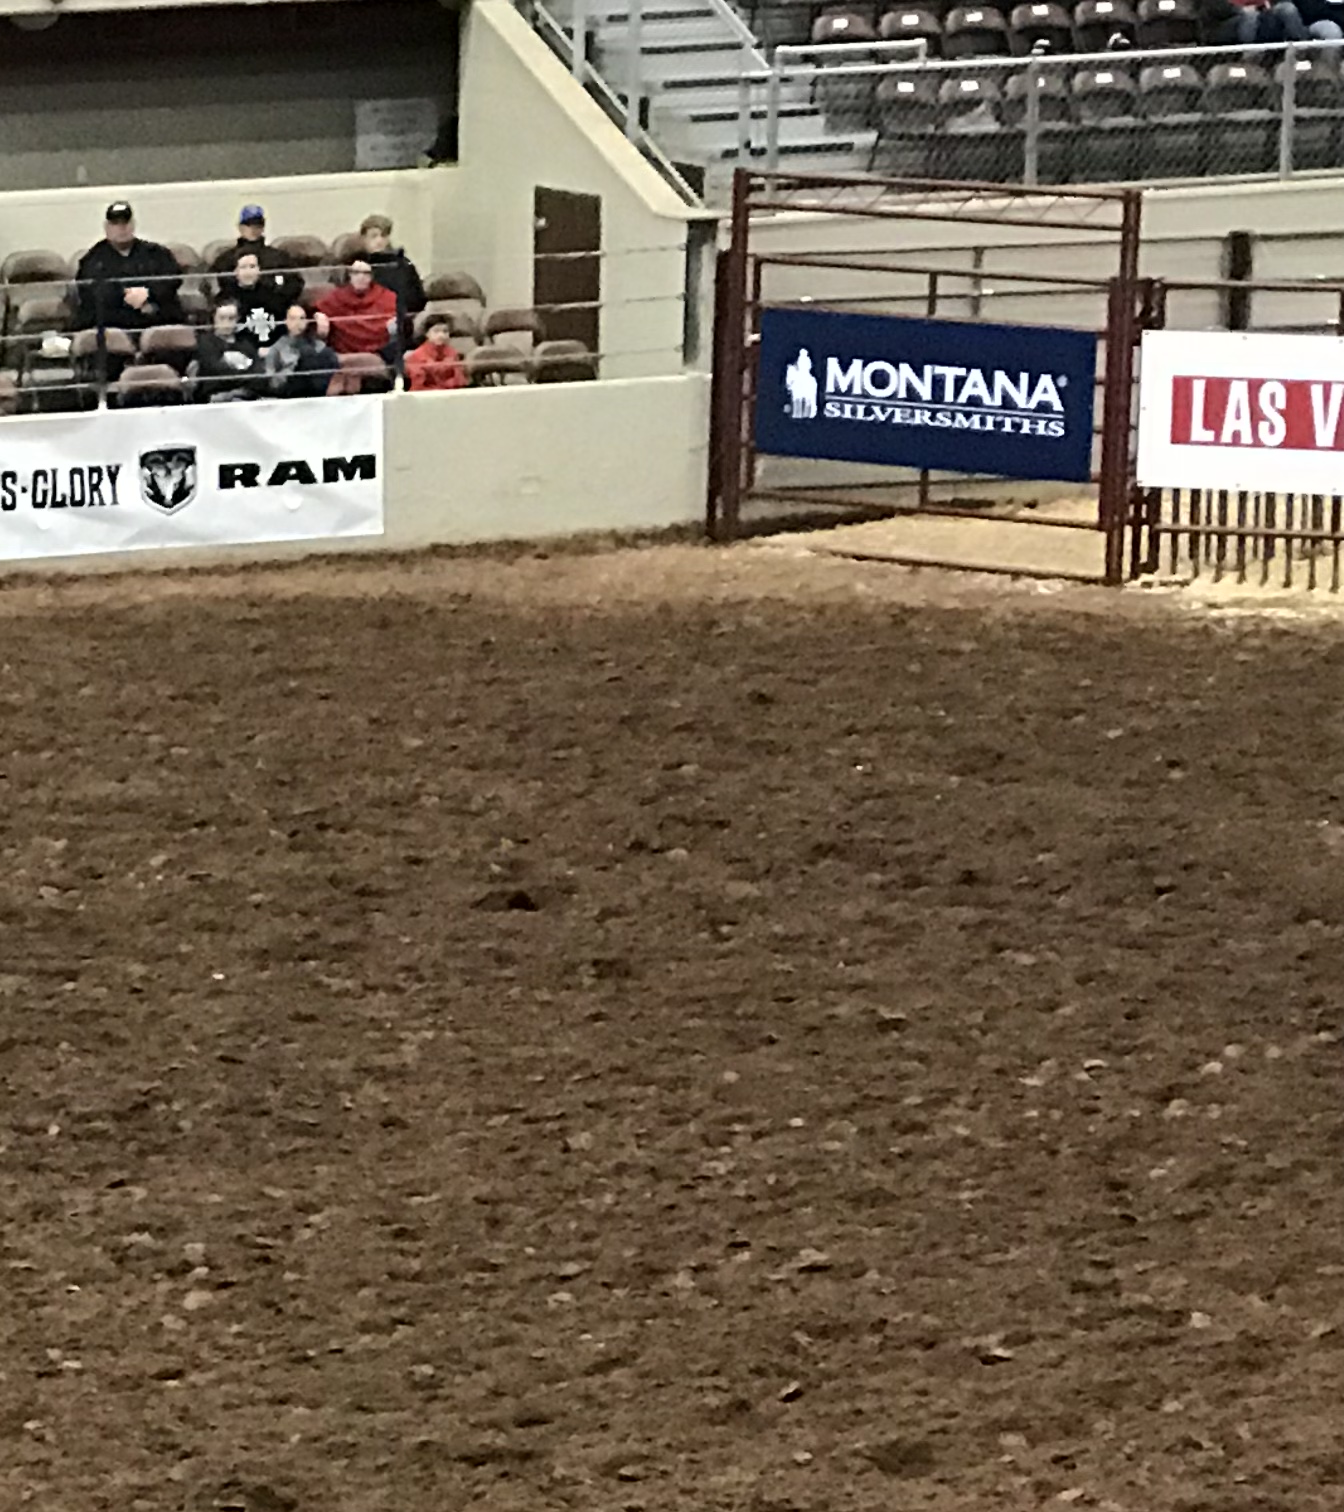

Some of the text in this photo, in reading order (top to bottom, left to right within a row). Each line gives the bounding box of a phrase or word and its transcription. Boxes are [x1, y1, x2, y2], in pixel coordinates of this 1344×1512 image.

[825, 356, 1065, 412] MONTANA
[823, 402, 1065, 437] SILVERSMITHS
[1190, 379, 1287, 447] LAS
[217, 454, 377, 491] RAM
